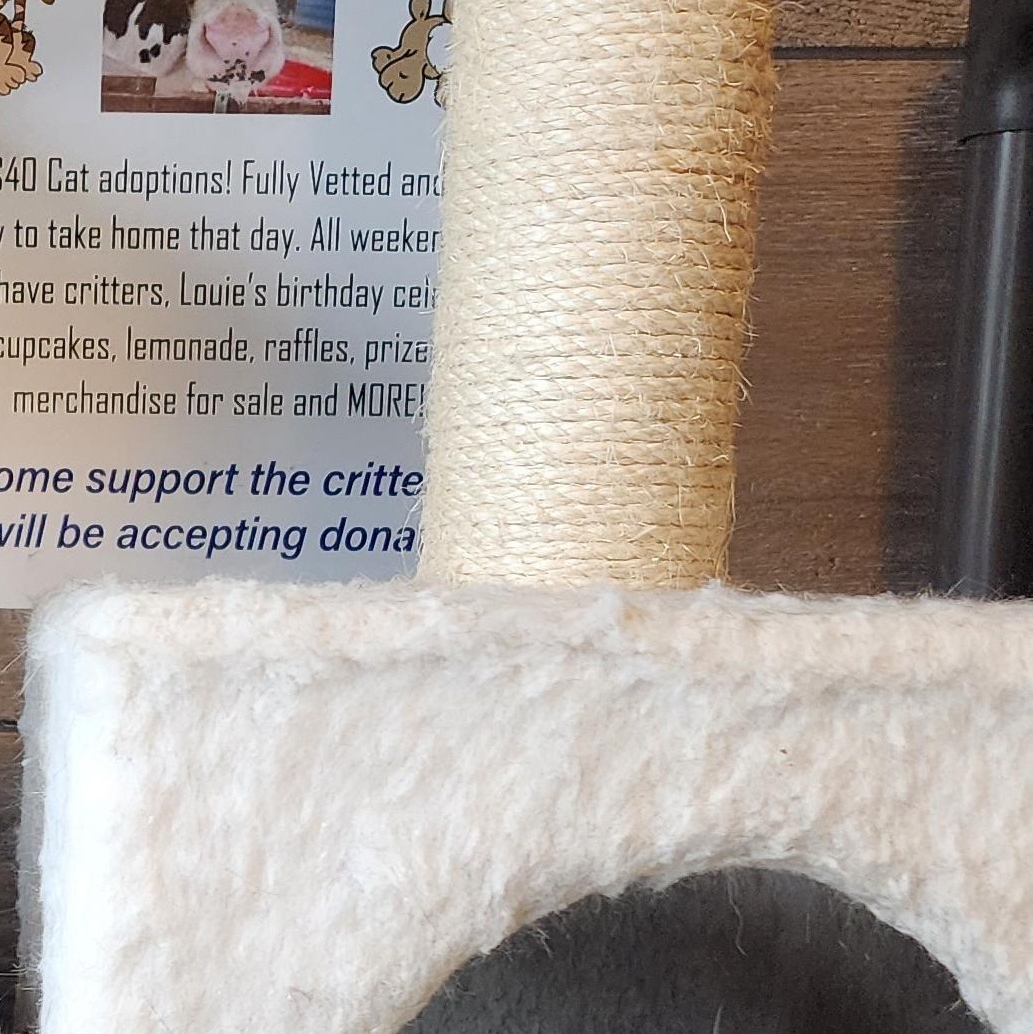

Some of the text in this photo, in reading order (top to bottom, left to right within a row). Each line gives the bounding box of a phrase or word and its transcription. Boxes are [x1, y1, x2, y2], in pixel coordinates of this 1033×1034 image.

[47, 157, 90, 194] Cat
[98, 157, 232, 202] adoptions!
[242, 159, 300, 204] Fully
[310, 159, 392, 197] Vetted
[13, 218, 38, 249] to
[47, 213, 102, 250] take
[111, 214, 180, 251] home
[189, 214, 241, 252] that
[250, 215, 301, 259] day.
[310, 216, 341, 252] All
[64, 274, 170, 309] critters,
[180, 270, 267, 307] Louie's
[276, 271, 385, 316] birthday
[126, 325, 255, 364] lemonade,
[264, 327, 355, 366] raffles,
[13, 379, 426, 418] merchandise for sale and MORE!
[85, 463, 240, 504] support
[250, 460, 311, 496] the
[56, 513, 105, 549] be
[116, 515, 308, 561] accepting
[318, 516, 424, 552] dona
